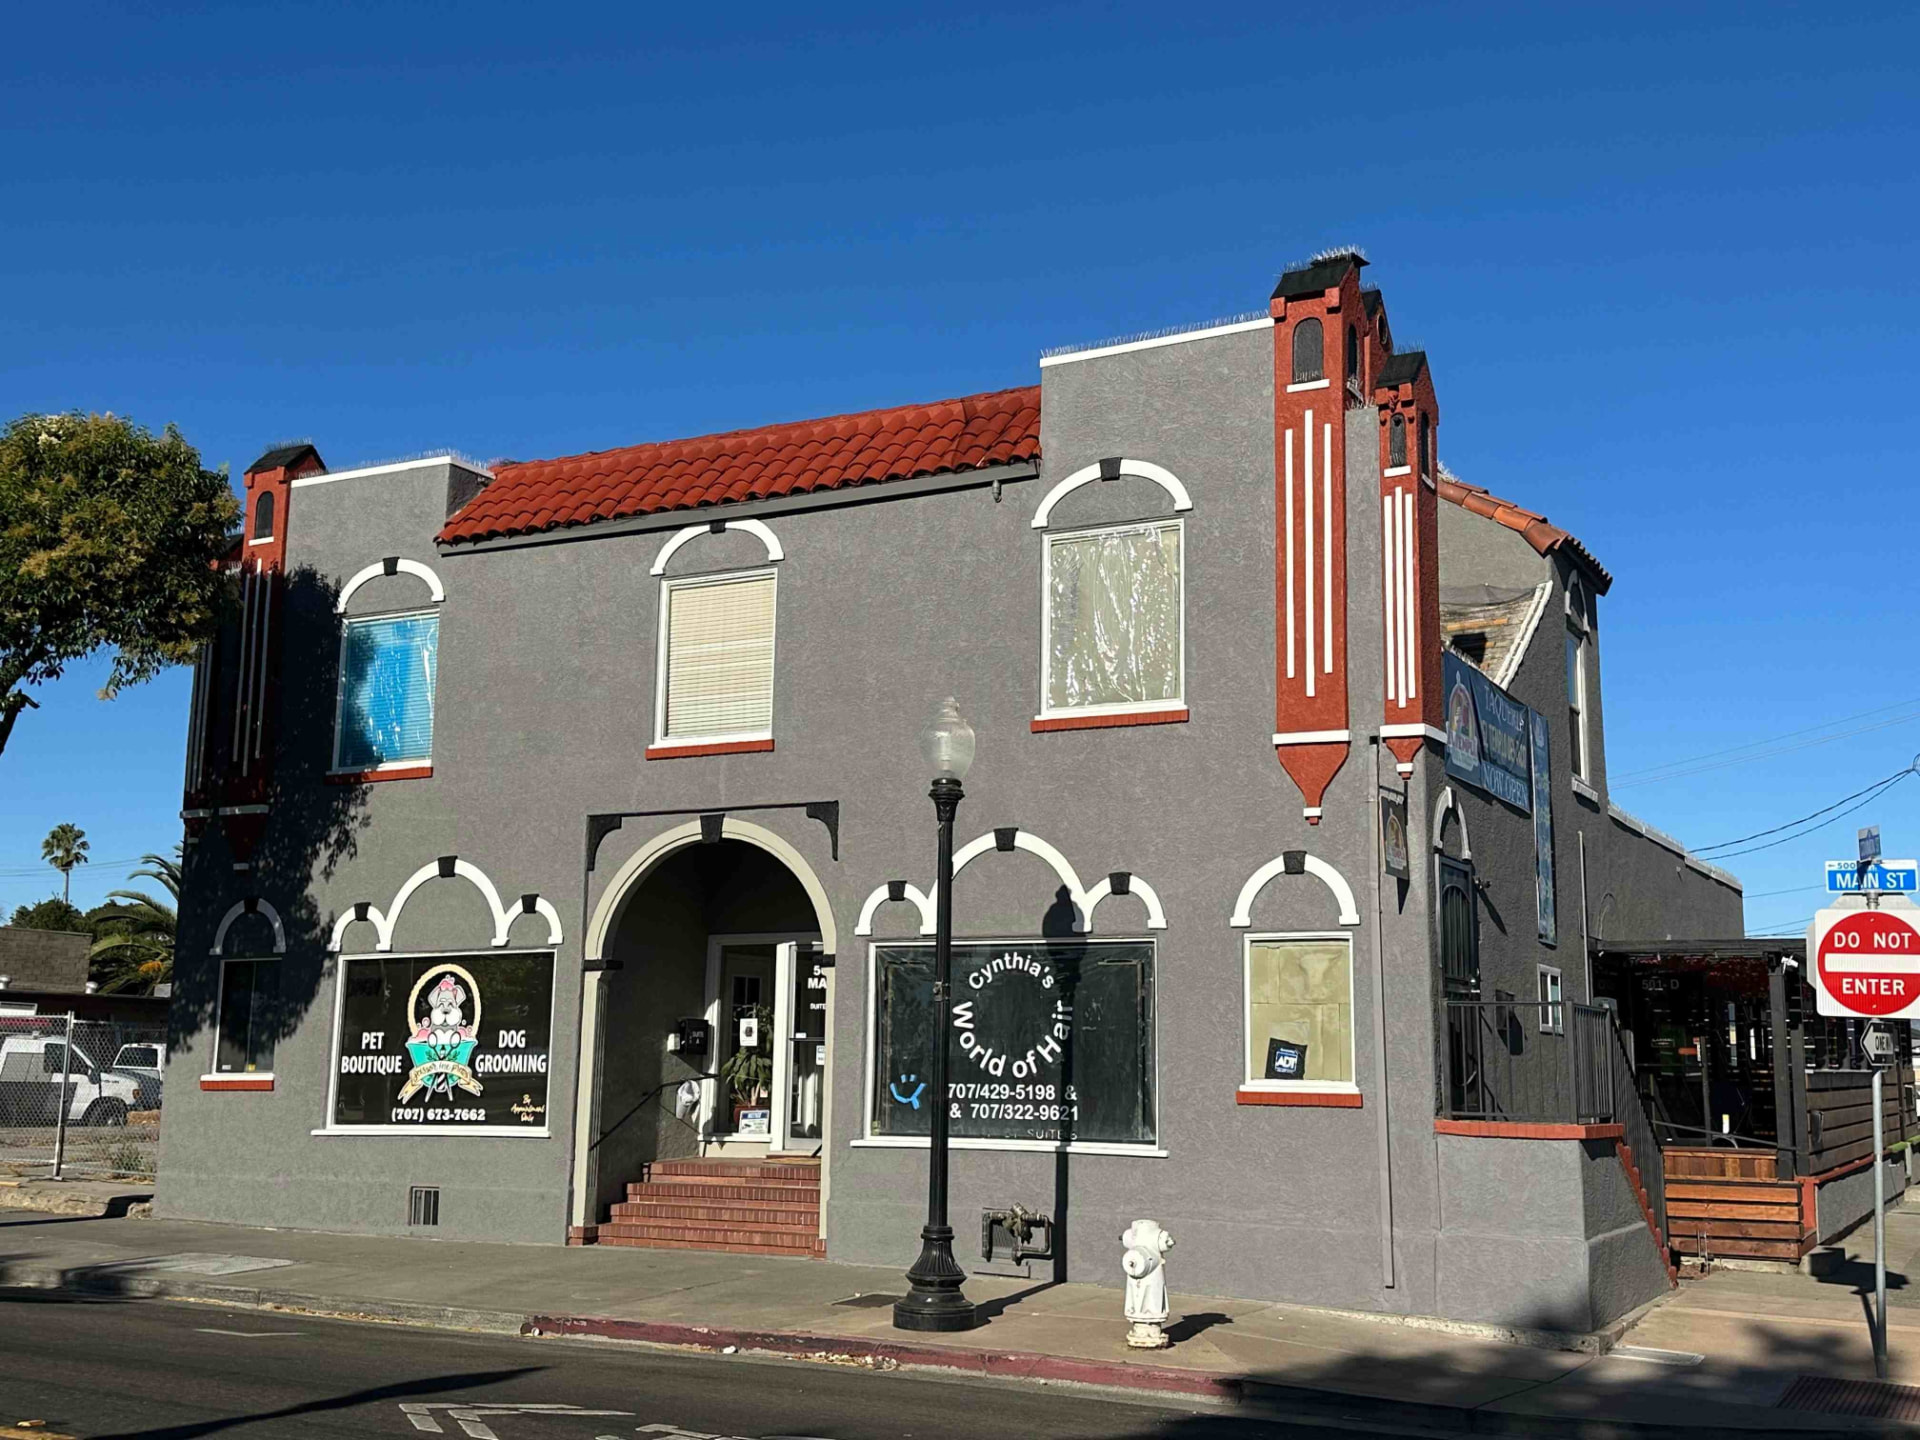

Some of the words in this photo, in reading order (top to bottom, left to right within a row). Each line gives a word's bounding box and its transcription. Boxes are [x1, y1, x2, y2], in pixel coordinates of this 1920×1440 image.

[1483, 763, 1503, 795] NOW
[1505, 780, 1528, 806] OPEN
[1837, 862, 1857, 870] 500
[1836, 872, 1880, 889] MAIN
[1886, 872, 1907, 888] ST
[1834, 932, 1860, 949] DO
[1874, 933, 1912, 949] NOT
[968, 951, 1055, 989] Cynthia's
[1842, 978, 1906, 996] ENTER
[361, 1031, 385, 1050] PET
[498, 1029, 526, 1049] DOG
[952, 1001, 1006, 1077] World
[1012, 1050, 1037, 1078] of
[1036, 1000, 1073, 1063] Hair
[1875, 1035, 1886, 1051] ONE
[341, 1055, 402, 1074] BOUTIQUE
[475, 1053, 547, 1073] GROOMING
[1276, 1055, 1296, 1069] ADT
[948, 1083, 1056, 1100] 707/429-5198
[1064, 1084, 1078, 1100] &
[391, 1107, 424, 1122] (707)
[427, 1108, 486, 1122] 673-7662
[949, 1102, 962, 1118] &
[970, 1103, 1079, 1120] 707/322-9621
[1027, 1128, 1064, 1140] SUITE
